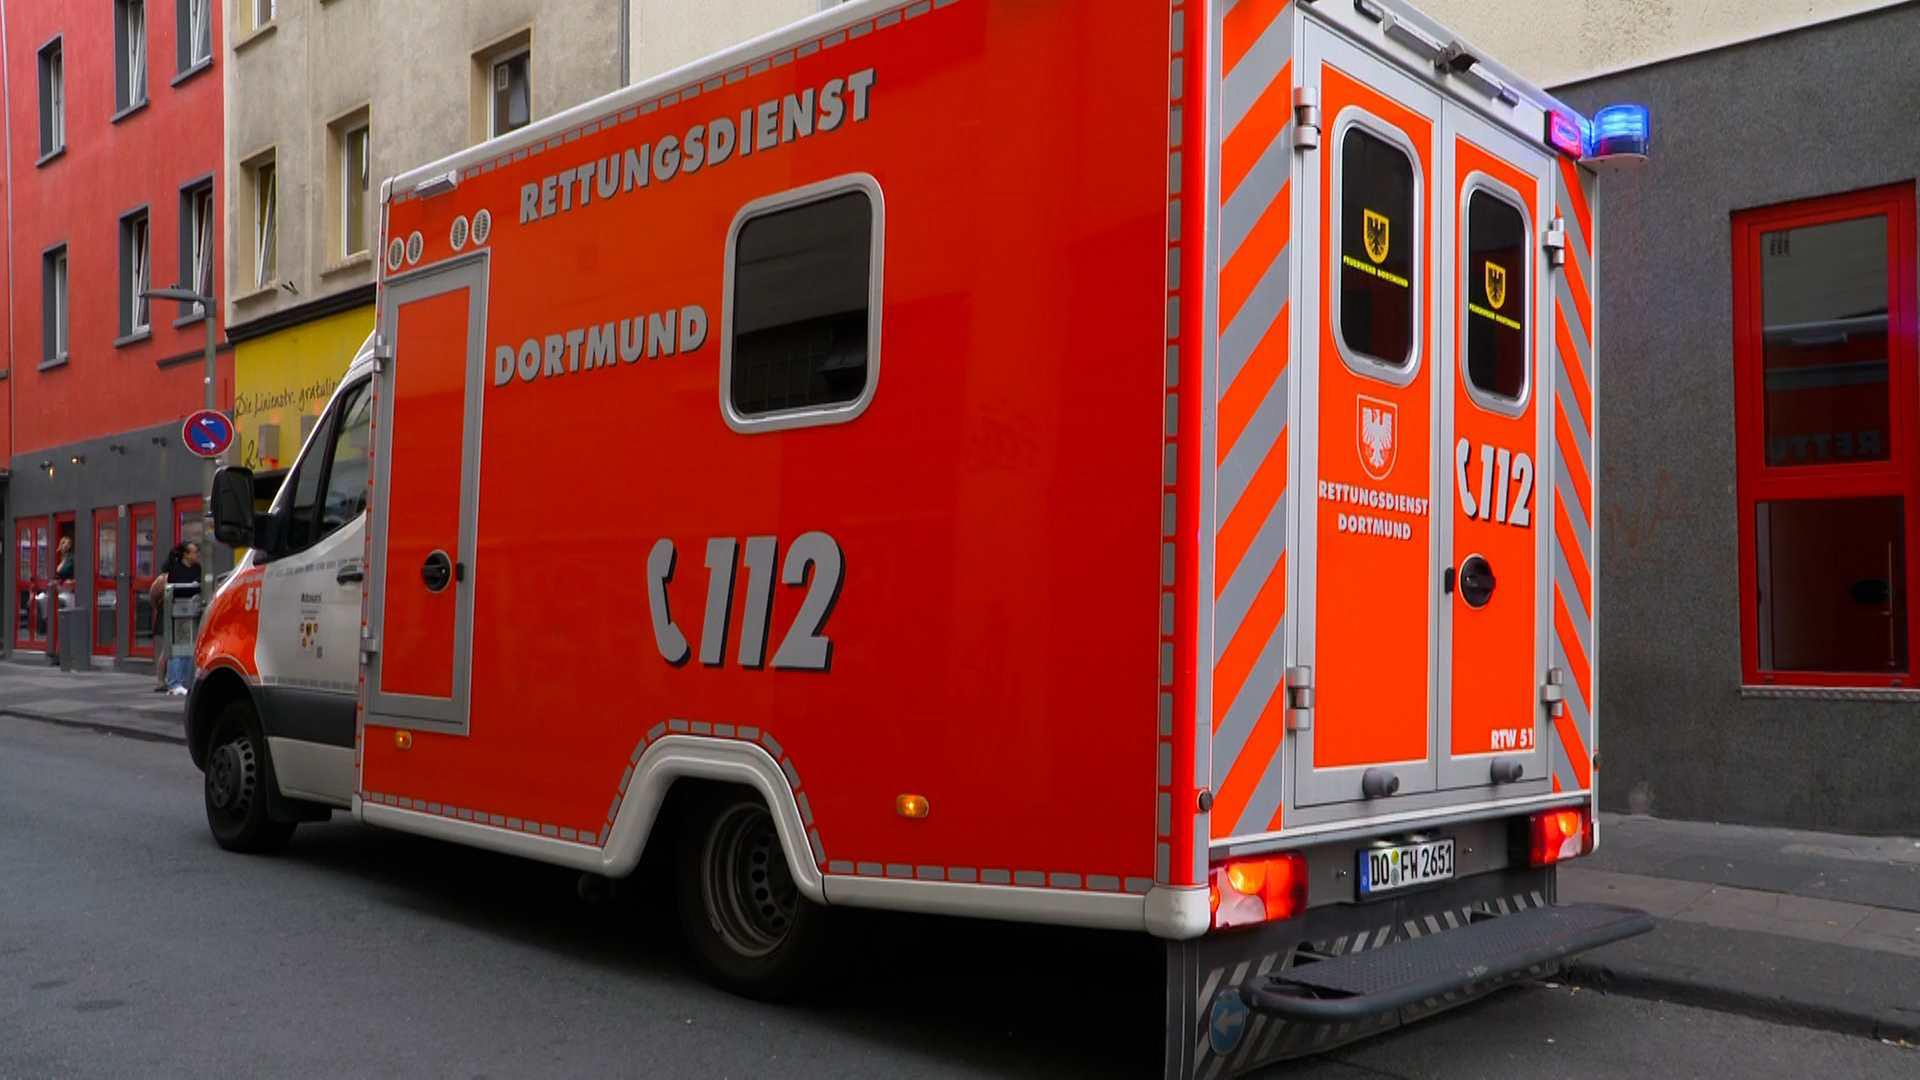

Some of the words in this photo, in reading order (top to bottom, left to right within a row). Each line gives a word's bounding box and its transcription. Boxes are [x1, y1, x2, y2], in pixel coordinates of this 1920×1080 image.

[519, 67, 877, 225] RETTUNGSDIENST
[494, 304, 708, 387] DORTMUND
[1318, 479, 1430, 516] RETTUNGSDIENST
[1478, 443, 1534, 527] 112
[1338, 513, 1412, 541] DORTMUND
[699, 530, 846, 674] 112
[1491, 729, 1518, 750] RTW
[1519, 728, 1535, 748] 51
[1370, 853, 1390, 887] DO
[1400, 849, 1418, 882] FW
[1422, 843, 1453, 879] 2651
